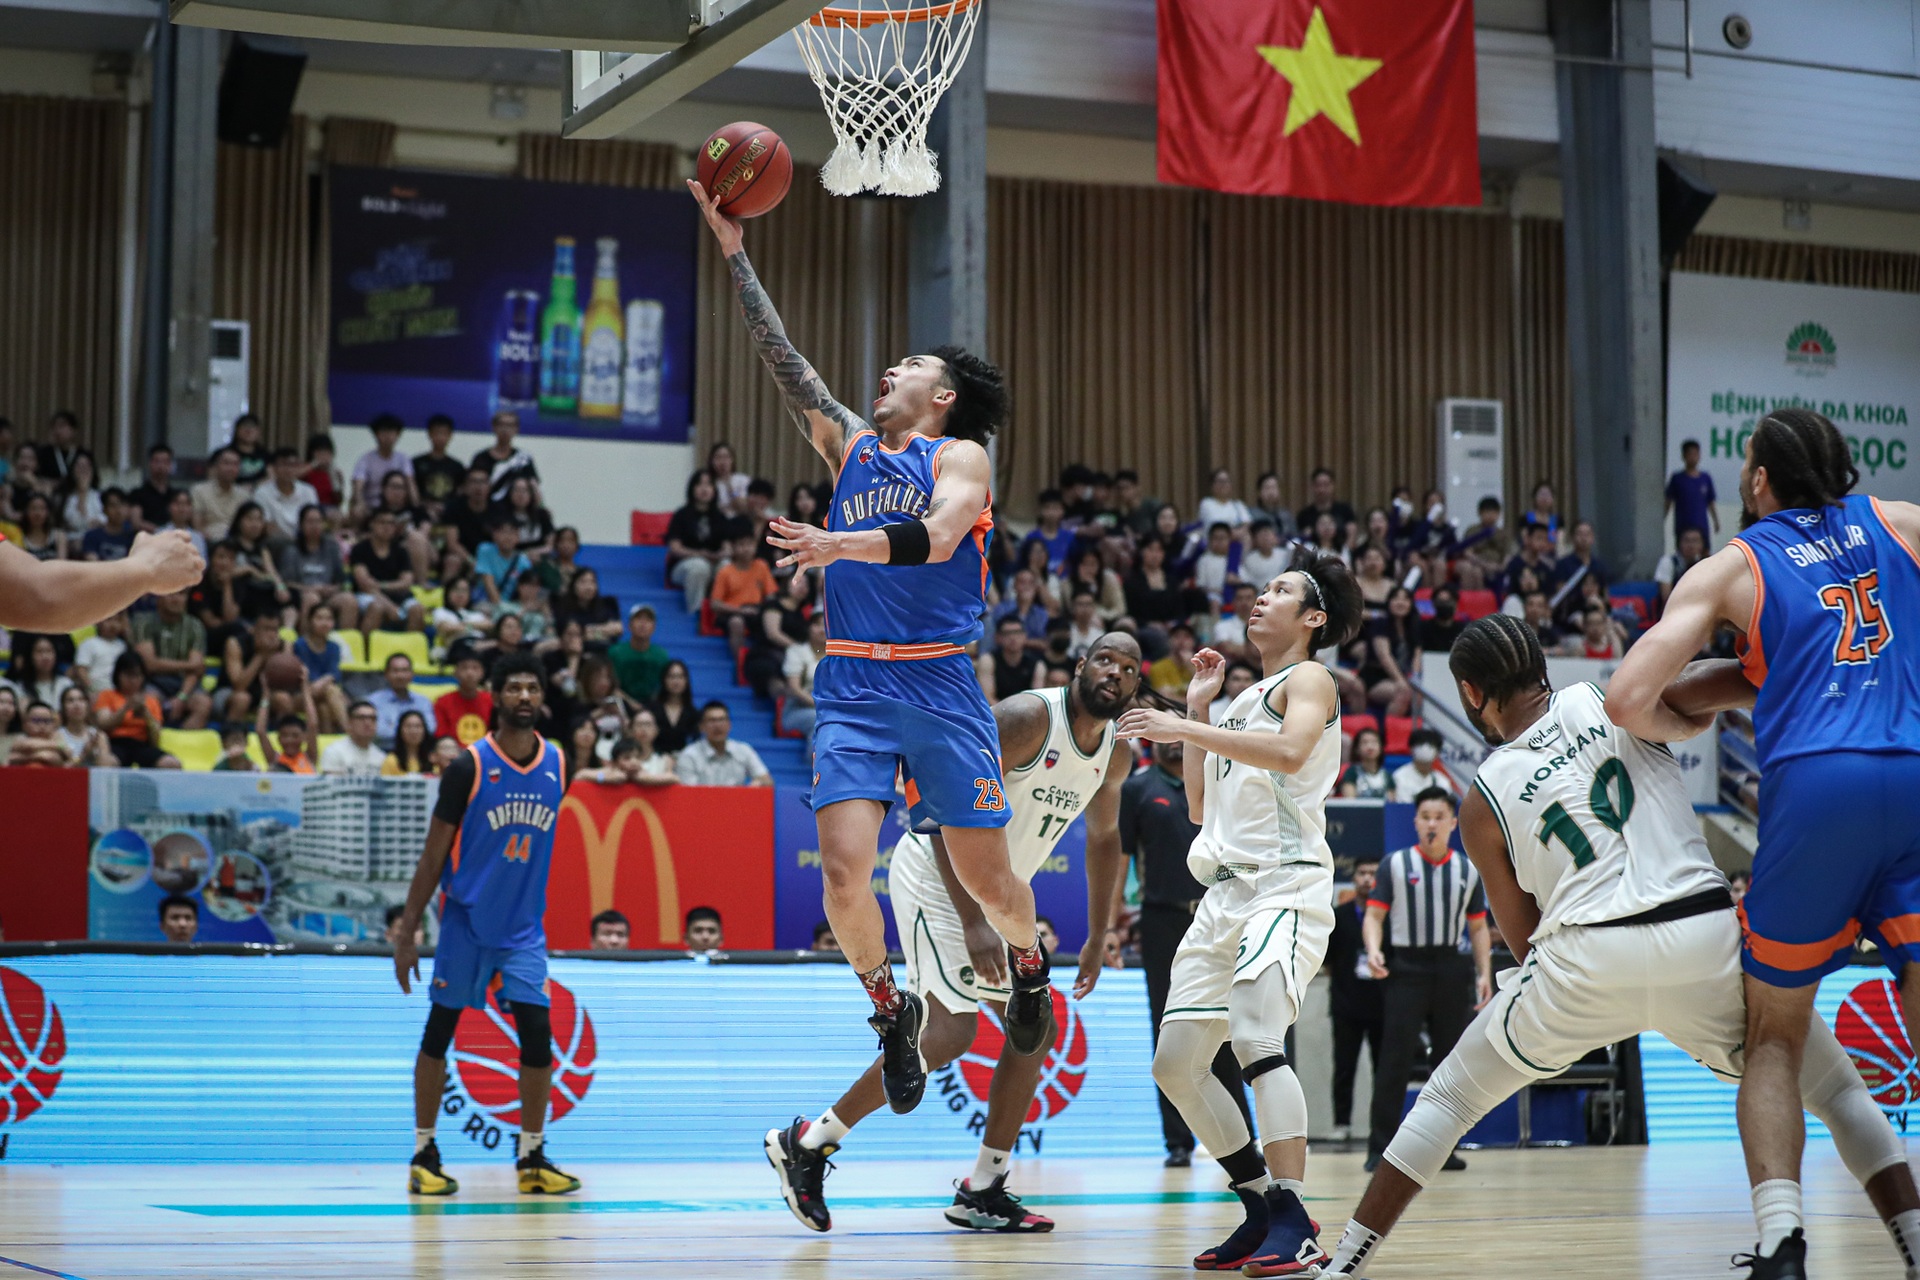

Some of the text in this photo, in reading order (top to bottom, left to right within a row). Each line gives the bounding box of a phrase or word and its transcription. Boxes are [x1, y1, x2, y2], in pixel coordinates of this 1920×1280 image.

[714, 138, 768, 197] SPALDING
[1854, 403, 1908, 426] KHOA
[1844, 524, 1868, 550] JR
[1816, 568, 1894, 666] 25
[1519, 724, 1608, 804] MORGAN
[973, 777, 1006, 812] 23
[1038, 813, 1069, 841] 17
[1534, 756, 1635, 870] 10
[502, 833, 531, 863] 44
[1014, 1128, 1043, 1154] TV
